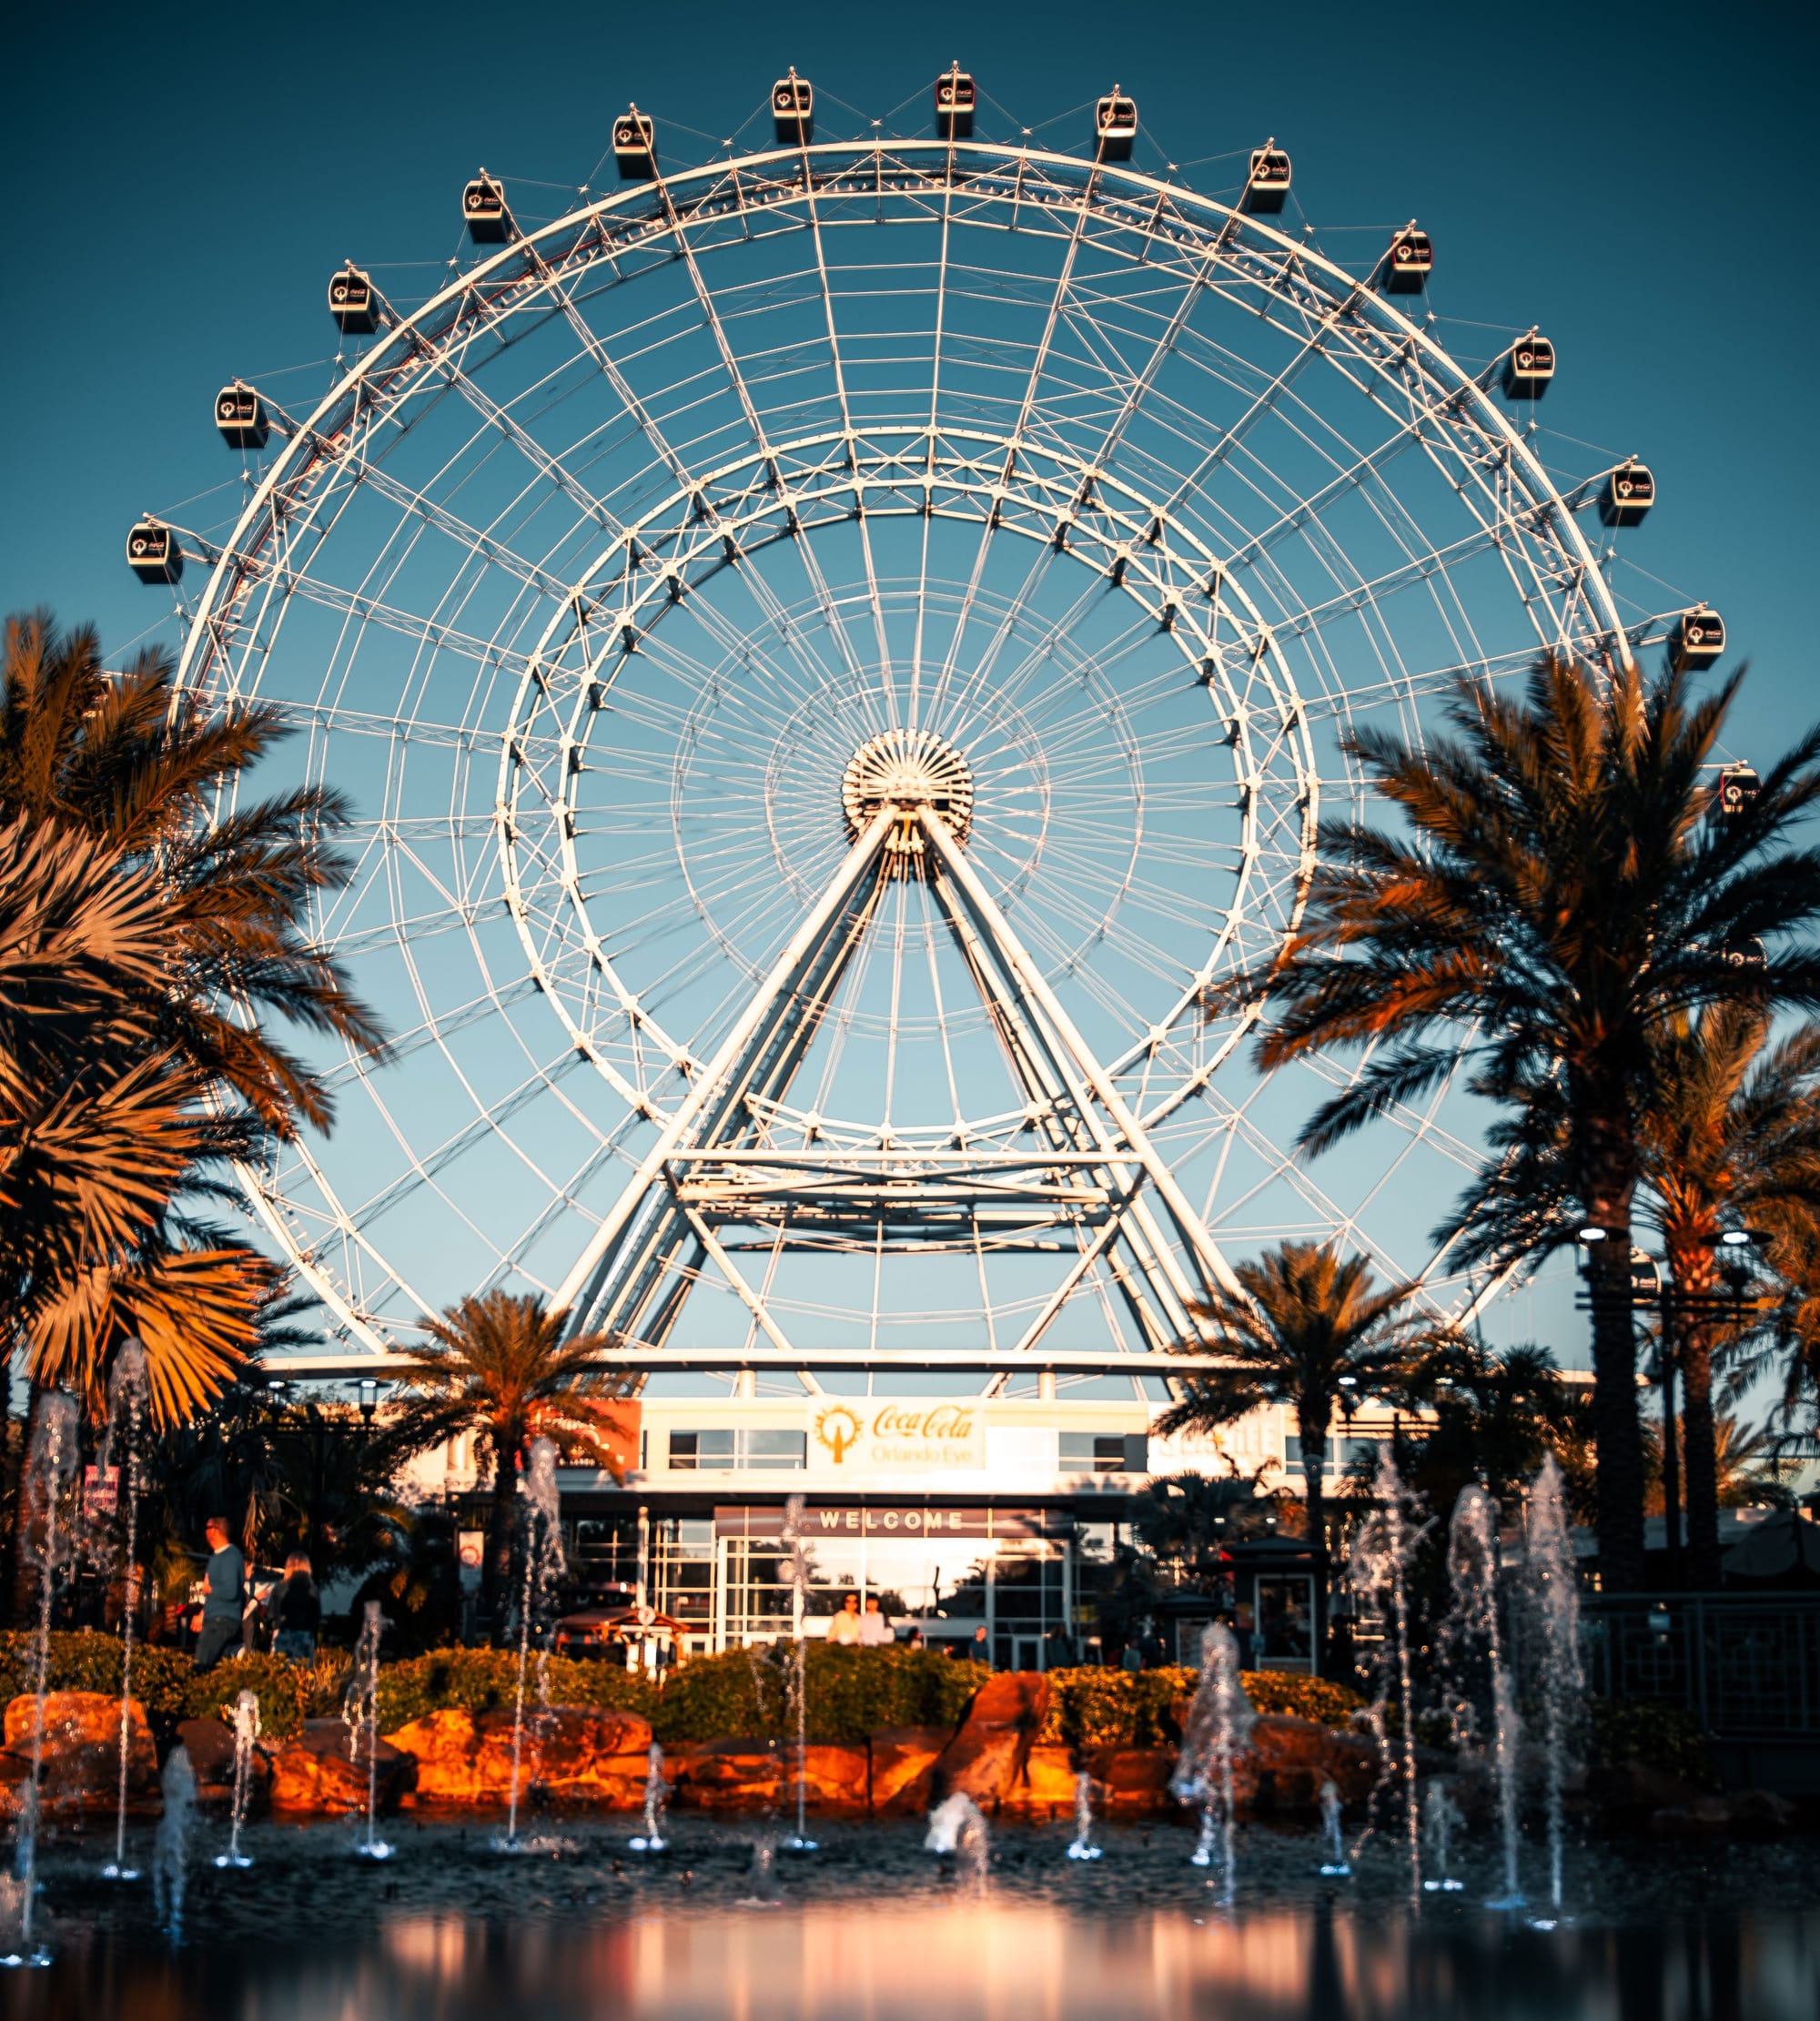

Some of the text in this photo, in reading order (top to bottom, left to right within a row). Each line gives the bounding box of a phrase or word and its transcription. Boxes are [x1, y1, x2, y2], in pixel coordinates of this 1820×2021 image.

[871, 1444, 972, 1467] Orlando Eye
[820, 1511, 963, 1530] WELCOME
